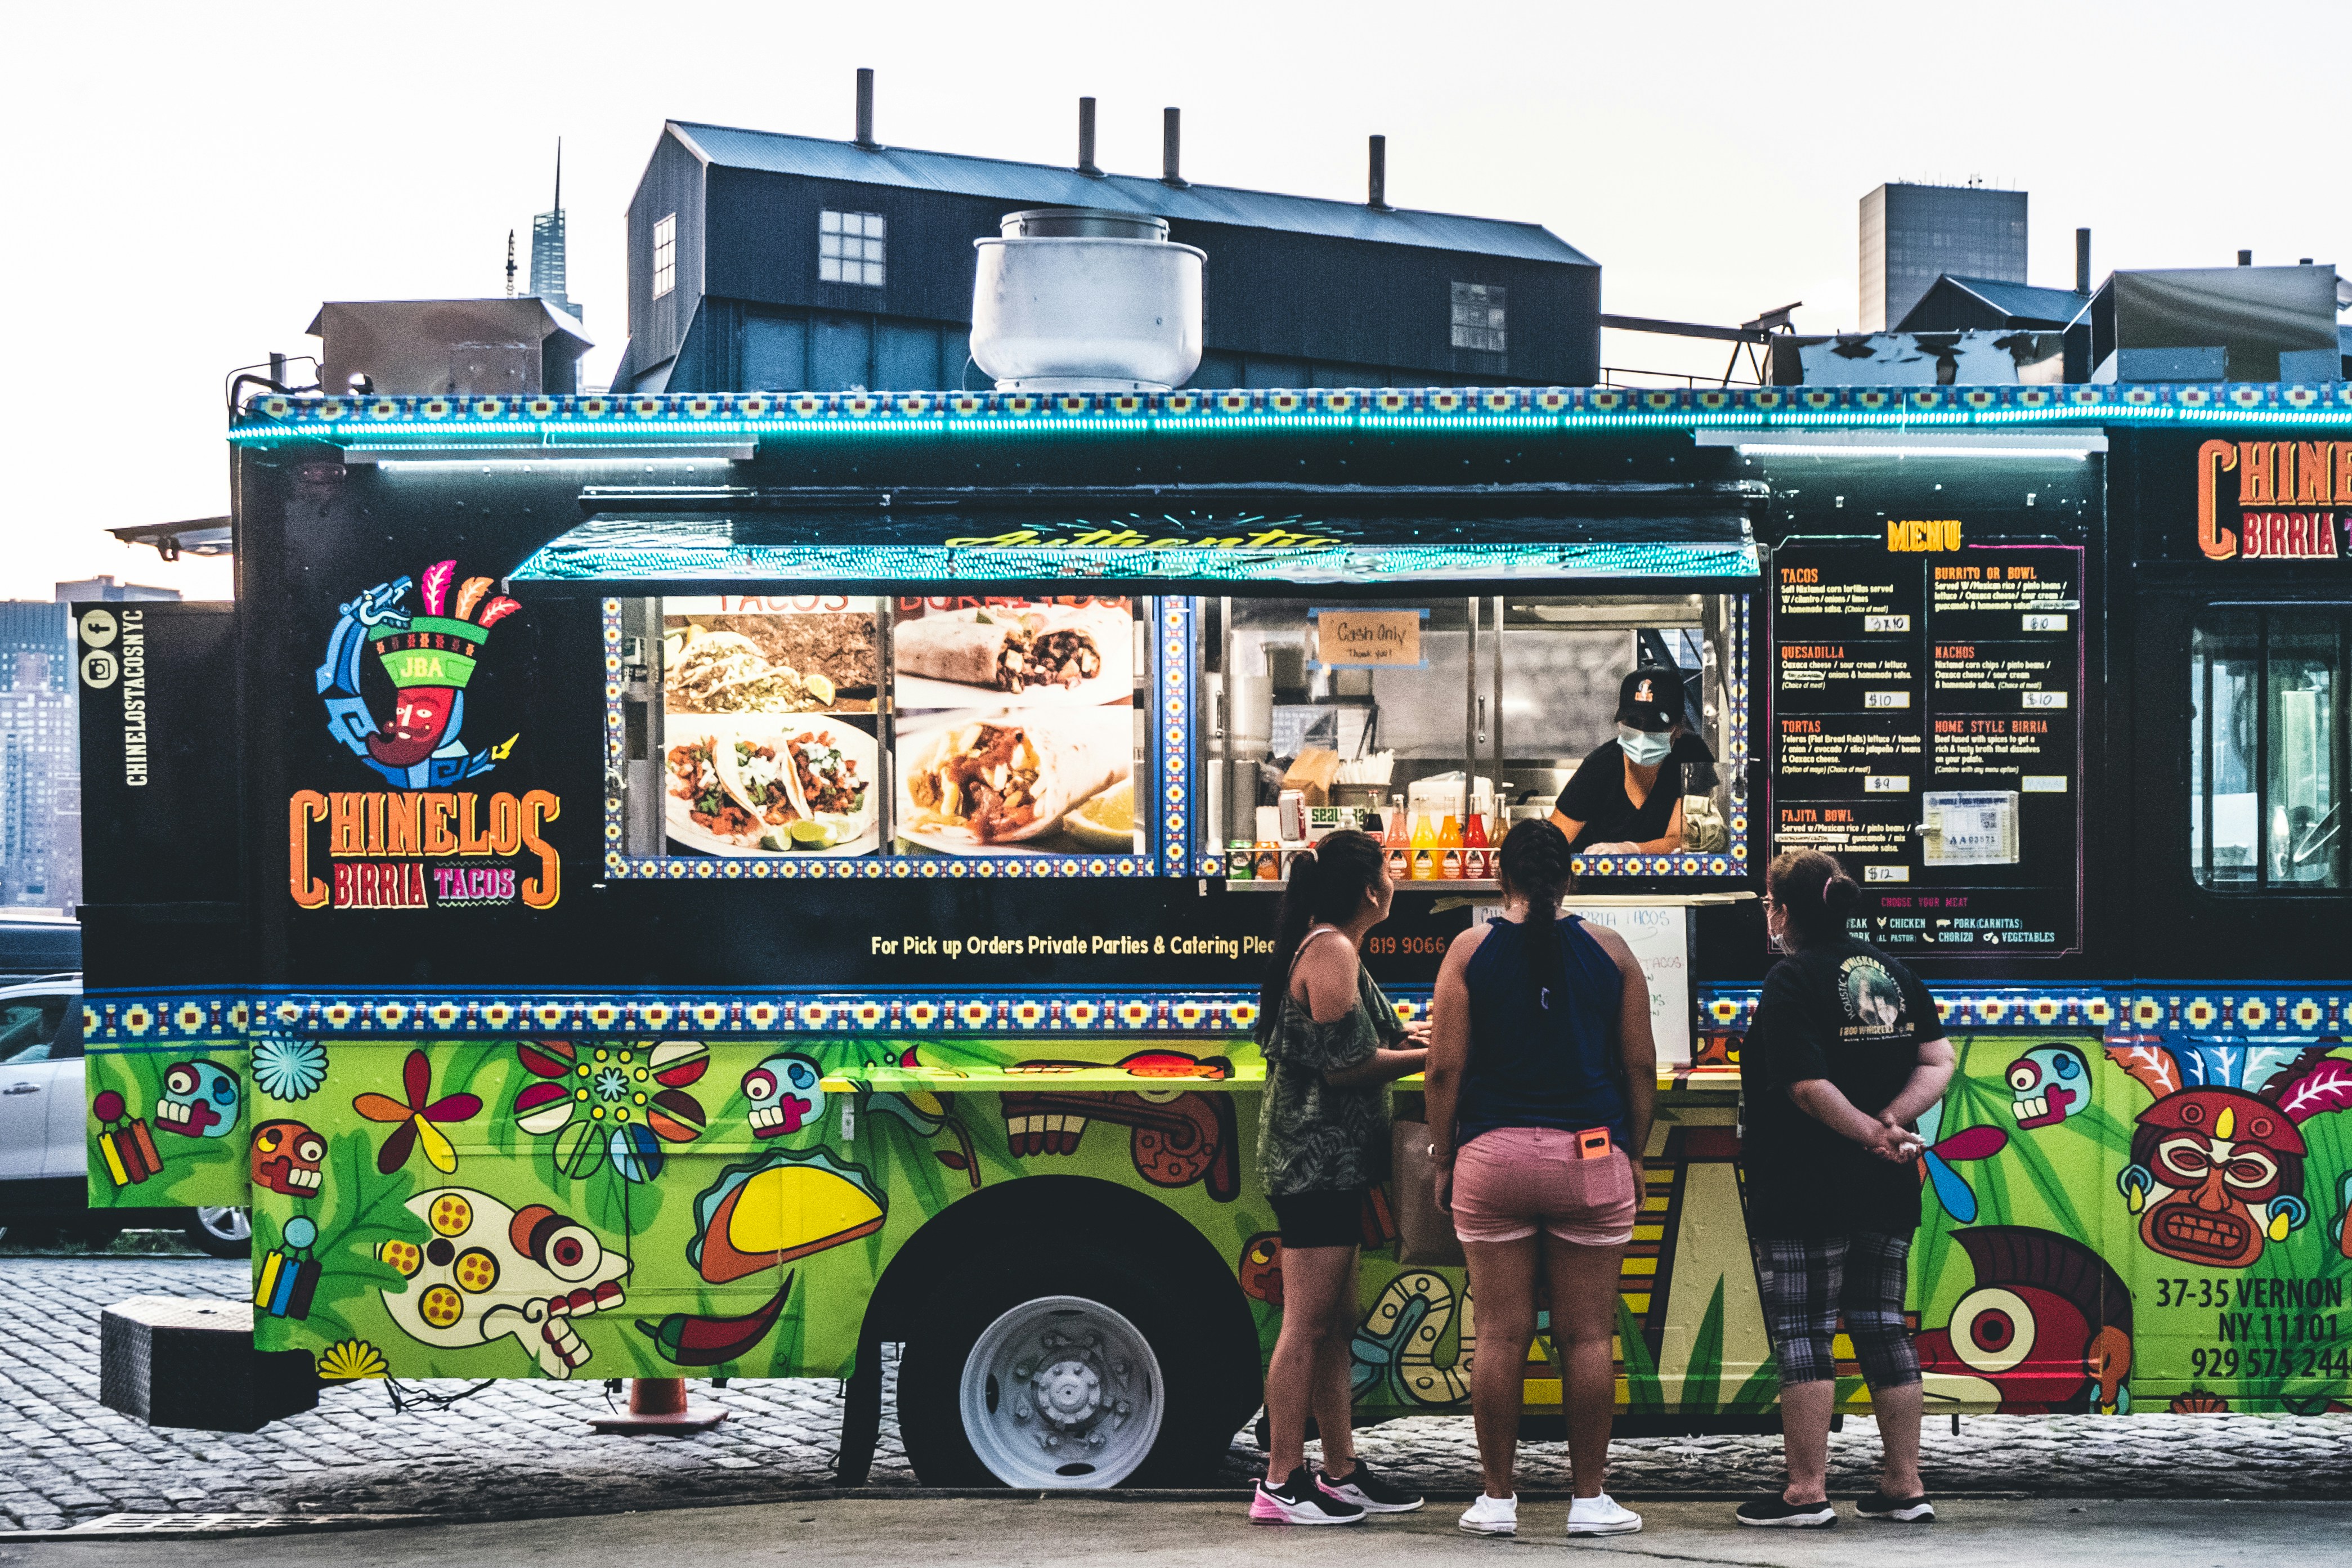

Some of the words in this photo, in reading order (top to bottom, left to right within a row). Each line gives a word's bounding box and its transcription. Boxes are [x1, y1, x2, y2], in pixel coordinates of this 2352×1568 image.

[1887, 519, 1964, 552] MENU
[2242, 512, 2338, 559] BIRRIA
[1781, 568, 1818, 584] TACOS
[1934, 566, 1981, 580] BURRITO
[1986, 567, 2000, 580] OR
[2008, 566, 2037, 580] BOWL
[1781, 646, 1844, 660] QUESADILLA
[1935, 646, 1974, 659] NACHOS
[401, 656, 444, 678] JBA
[122, 610, 148, 786] CHINELOSTACOSNYC
[1868, 693, 1892, 706] $10
[1781, 720, 1821, 733] TORTAS
[1935, 720, 1964, 733] HOME
[1971, 720, 2005, 733] STYLE
[2011, 720, 2048, 733] BIRRIA
[1781, 809, 1817, 822] FAJITA
[1825, 809, 1854, 822] BOWL
[290, 789, 561, 909] CHINELOS
[1867, 867, 1894, 880] $12
[334, 862, 428, 909] BIRRIA
[433, 867, 516, 901] TACOS
[1881, 897, 1912, 907] CHOOSE
[1919, 897, 1939, 907] YOUR
[1945, 897, 1968, 907] MEAT
[1889, 918, 1926, 929] CHICKEN
[1938, 931, 1974, 943] CHORIZO
[2001, 931, 2055, 943] VEGETABLES
[871, 936, 899, 955] For
[903, 936, 938, 955] Pick
[943, 940, 962, 960] up
[967, 935, 1024, 955] Orders
[1028, 935, 1087, 954] Private
[1092, 935, 1149, 955] Parties
[1153, 935, 1166, 955] &
[1170, 935, 1238, 960] Catering
[1369, 937, 1396, 954] 819
[1401, 937, 1446, 954] 9066
[2156, 1278, 2230, 1308] 37-35
[2235, 1278, 2342, 1308] VERNON
[2219, 1312, 2254, 1343] NY
[2260, 1313, 2338, 1343] 11101
[2192, 1348, 2239, 1378] 929
[2246, 1348, 2293, 1378] 575
[2301, 1348, 2352, 1378] 244
